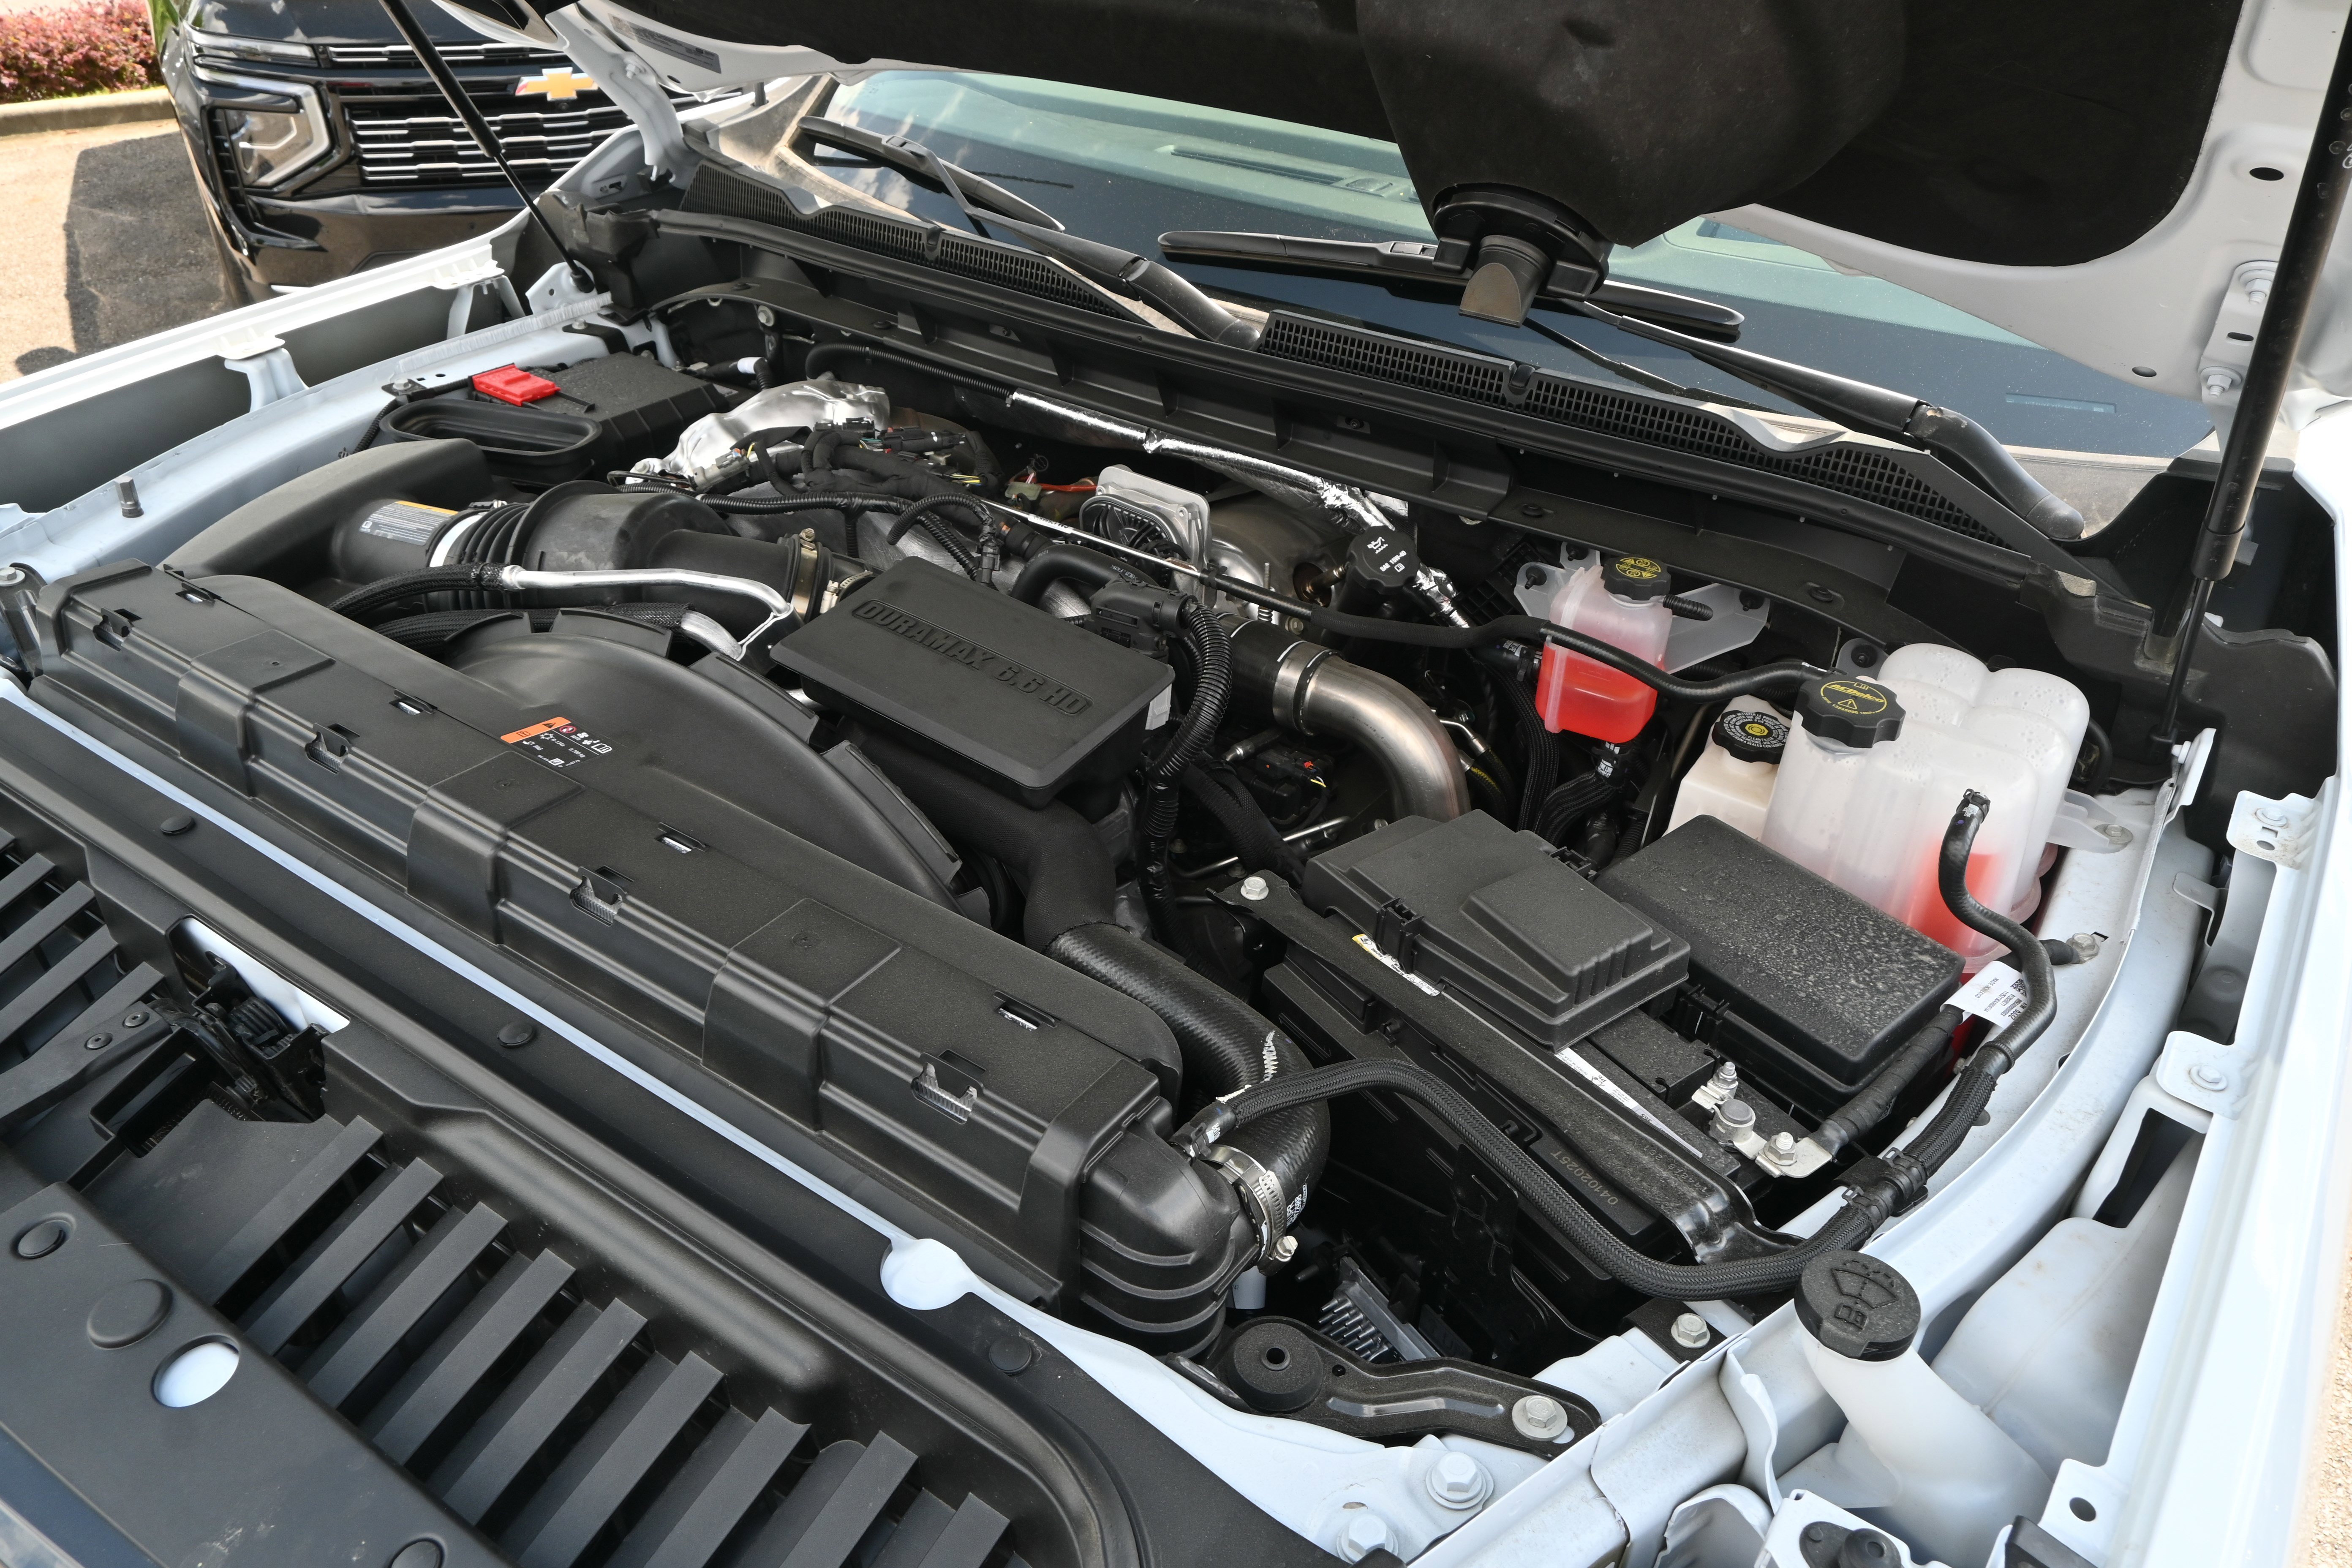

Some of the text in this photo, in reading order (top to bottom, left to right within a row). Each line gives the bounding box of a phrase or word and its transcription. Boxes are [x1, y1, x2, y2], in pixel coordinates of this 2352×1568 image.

[1380, 550, 1407, 572] SAE 15W-40
[857, 601, 1089, 715] DURAMAX 6.6 HD
[1829, 684, 1884, 702] ACDelco
[1988, 977, 1999, 986] MADE
[1598, 1075, 1607, 1083] Pb
[1641, 1113, 1653, 1123] 365
[1551, 1150, 1619, 1205] 04102025T
